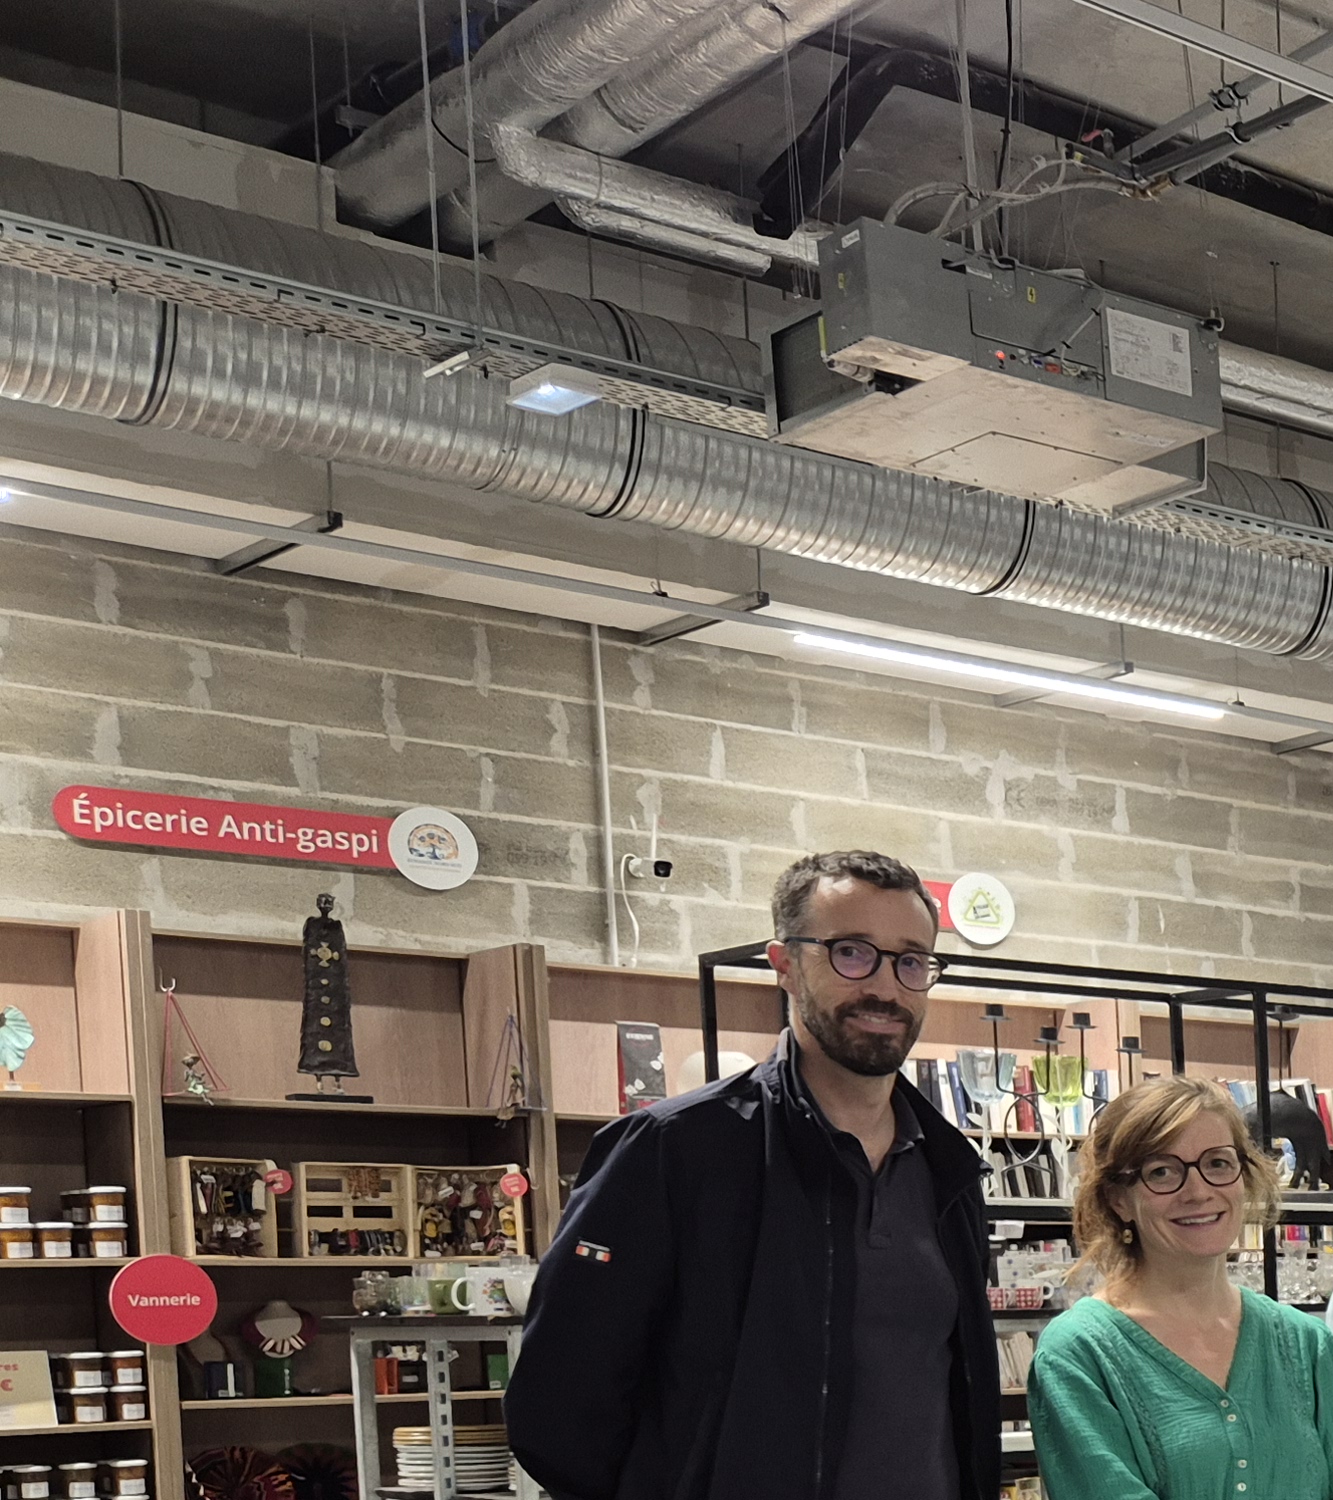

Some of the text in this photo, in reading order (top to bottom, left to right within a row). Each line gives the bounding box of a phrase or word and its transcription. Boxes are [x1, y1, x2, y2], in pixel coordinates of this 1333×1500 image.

[72, 792, 380, 858] Épicerie Anti-gaspi
[127, 1293, 201, 1307] Vannerie
